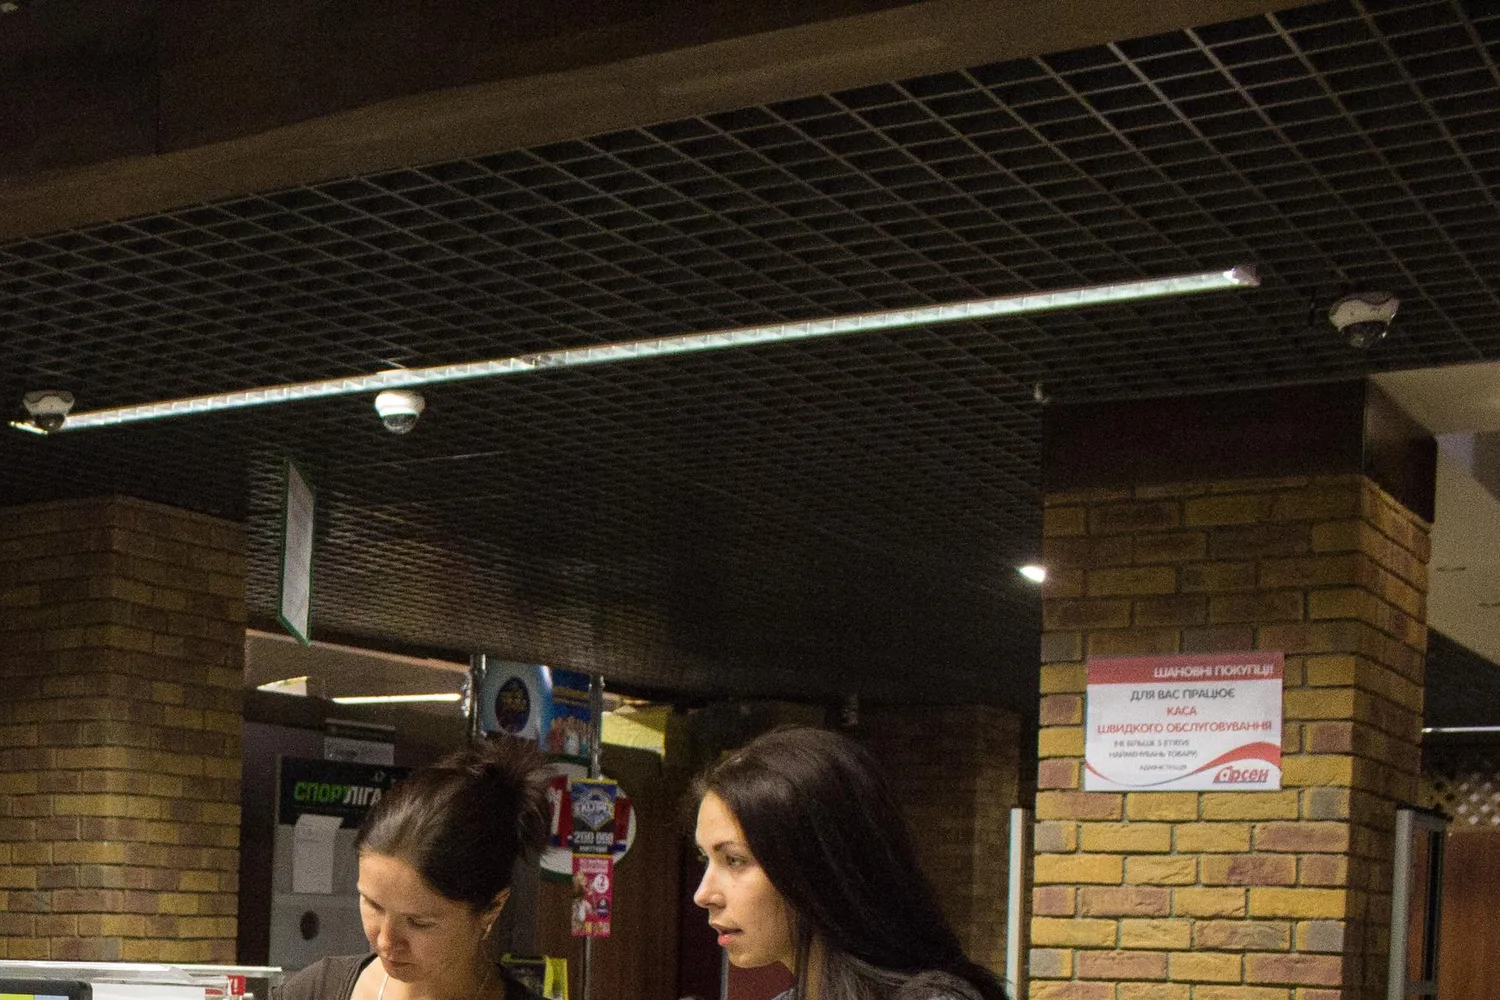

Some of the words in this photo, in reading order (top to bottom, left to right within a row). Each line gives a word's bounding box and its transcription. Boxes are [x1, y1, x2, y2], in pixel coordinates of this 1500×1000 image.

[1130, 689, 1154, 702] ДЛЯ
[1157, 689, 1180, 700] ВАС
[1182, 687, 1235, 701] ПРАЦЮЄ
[1166, 706, 1197, 717] КАСА
[1097, 723, 1163, 735] ШВИДКОГО
[1166, 720, 1272, 733] ОБСЛУГОВУВАННЯ
